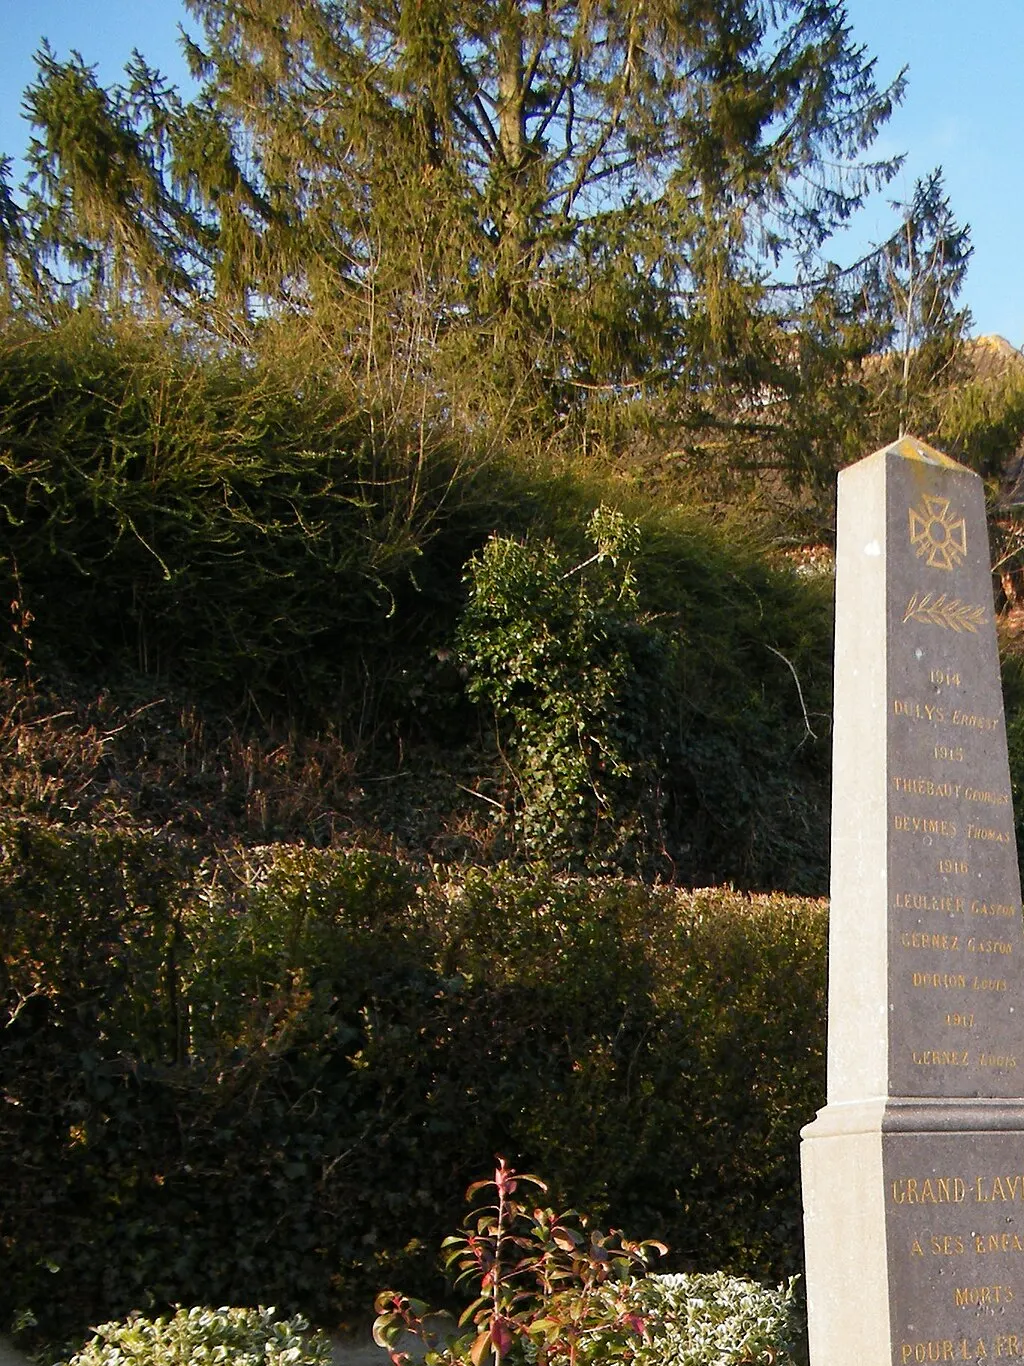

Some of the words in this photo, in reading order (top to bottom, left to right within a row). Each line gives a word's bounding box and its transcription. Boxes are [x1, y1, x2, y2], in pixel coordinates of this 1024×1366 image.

[891, 1177, 965, 1204] GRAND
[911, 1239, 924, 1256] A
[931, 1236, 964, 1255] SES
[955, 1286, 1014, 1306] MORTS
[901, 1340, 954, 1364] POUR
[962, 1338, 987, 1360] LA
